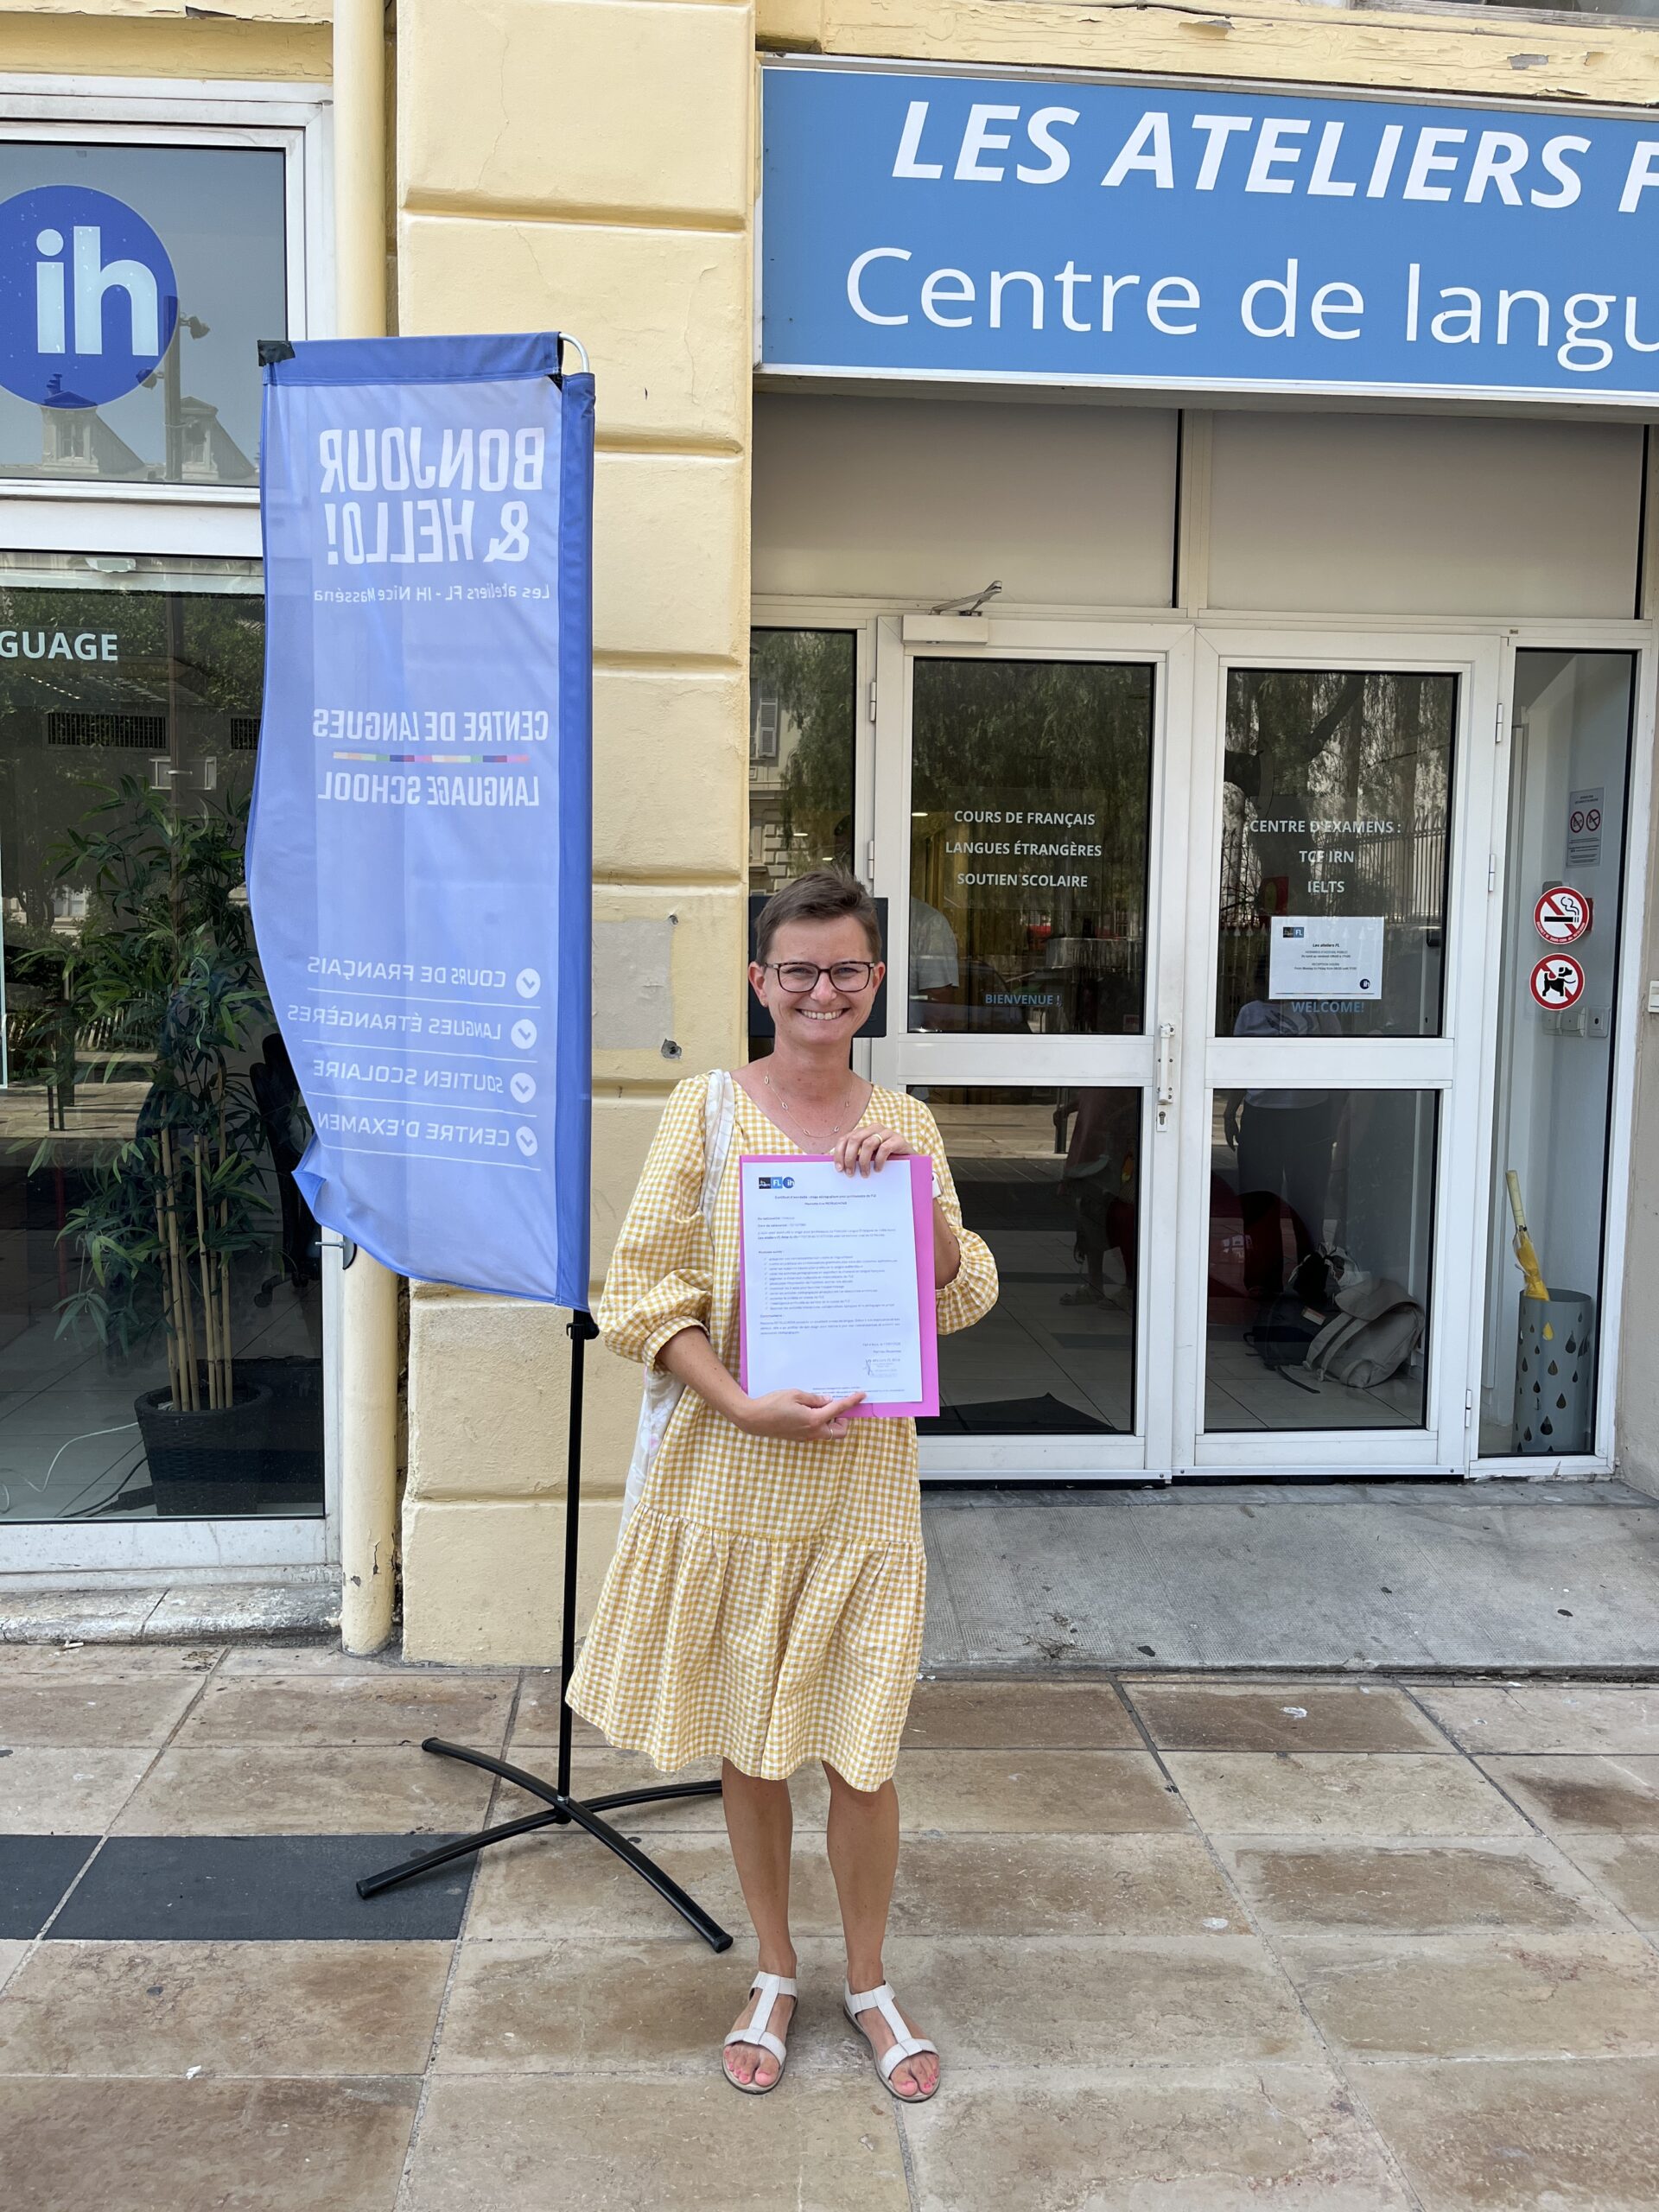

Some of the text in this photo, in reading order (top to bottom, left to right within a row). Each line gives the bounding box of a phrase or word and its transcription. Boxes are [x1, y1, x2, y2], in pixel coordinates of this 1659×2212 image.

[892, 100, 1080, 185] LES
[1102, 111, 1592, 209] ATELIERS
[36, 226, 159, 356] ih
[847, 247, 1659, 372] Centre de langu
[0, 630, 118, 661] GUAGE
[954, 810, 1096, 828] COURS DE FRANÇAIS
[1250, 820, 1306, 833] CENTRE
[945, 840, 1103, 857] LANGUES ÉTRANGÈRES
[1299, 850, 1354, 863] TCF IRN
[957, 873, 1088, 887] SOUTIEN SCOLAIRE
[1307, 880, 1344, 893] IELTS
[985, 994, 1053, 1005] BIENVENUE
[1291, 1001, 1364, 1013] WELCOME!
